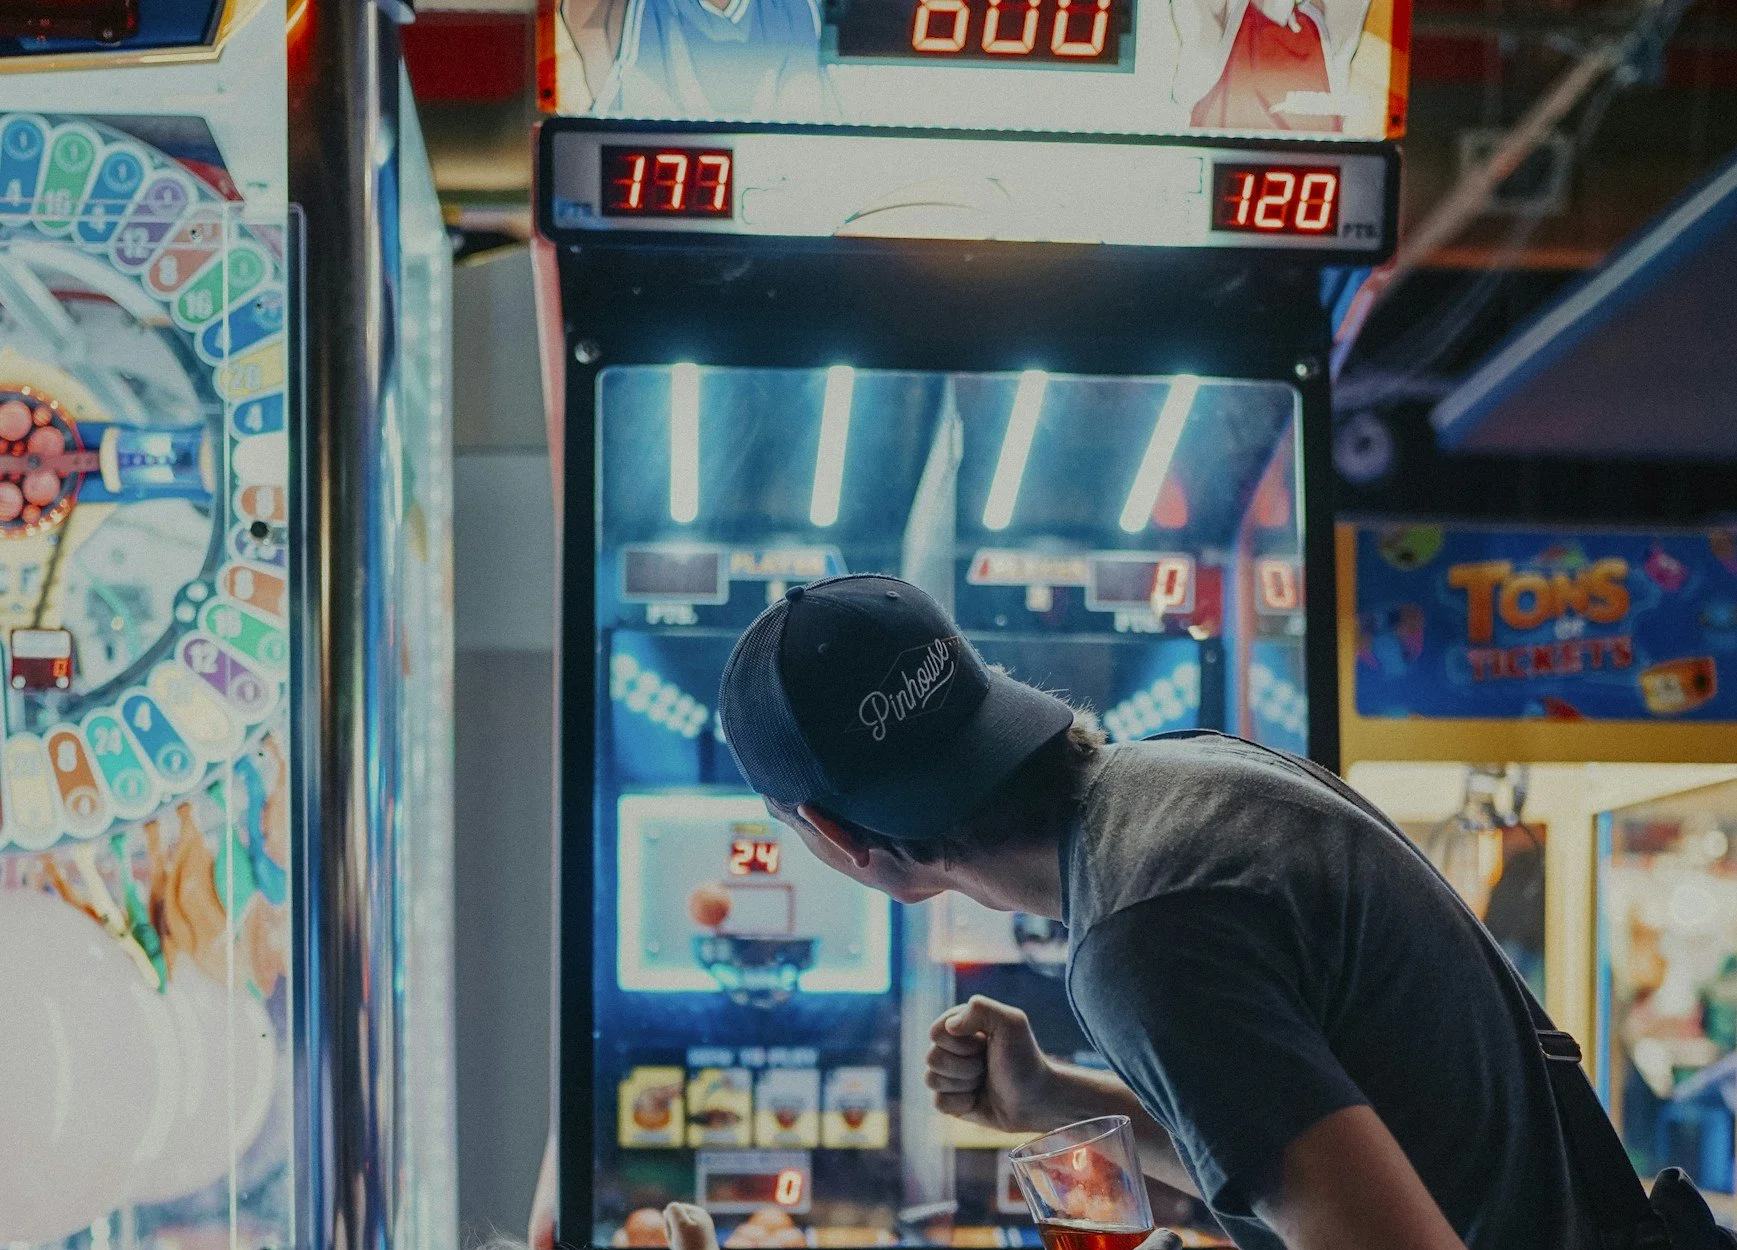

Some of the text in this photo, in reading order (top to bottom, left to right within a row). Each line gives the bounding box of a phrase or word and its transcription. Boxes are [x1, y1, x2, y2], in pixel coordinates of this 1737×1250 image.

[629, 154, 730, 211] 177
[1237, 171, 1337, 230] 120
[1152, 557, 1190, 606] 0
[1448, 556, 1630, 643] TONS
[1467, 636, 1633, 681] TICKETS
[858, 638, 950, 741] Pinhouse
[729, 839, 780, 875] 24
[774, 1168, 804, 1206] 0
